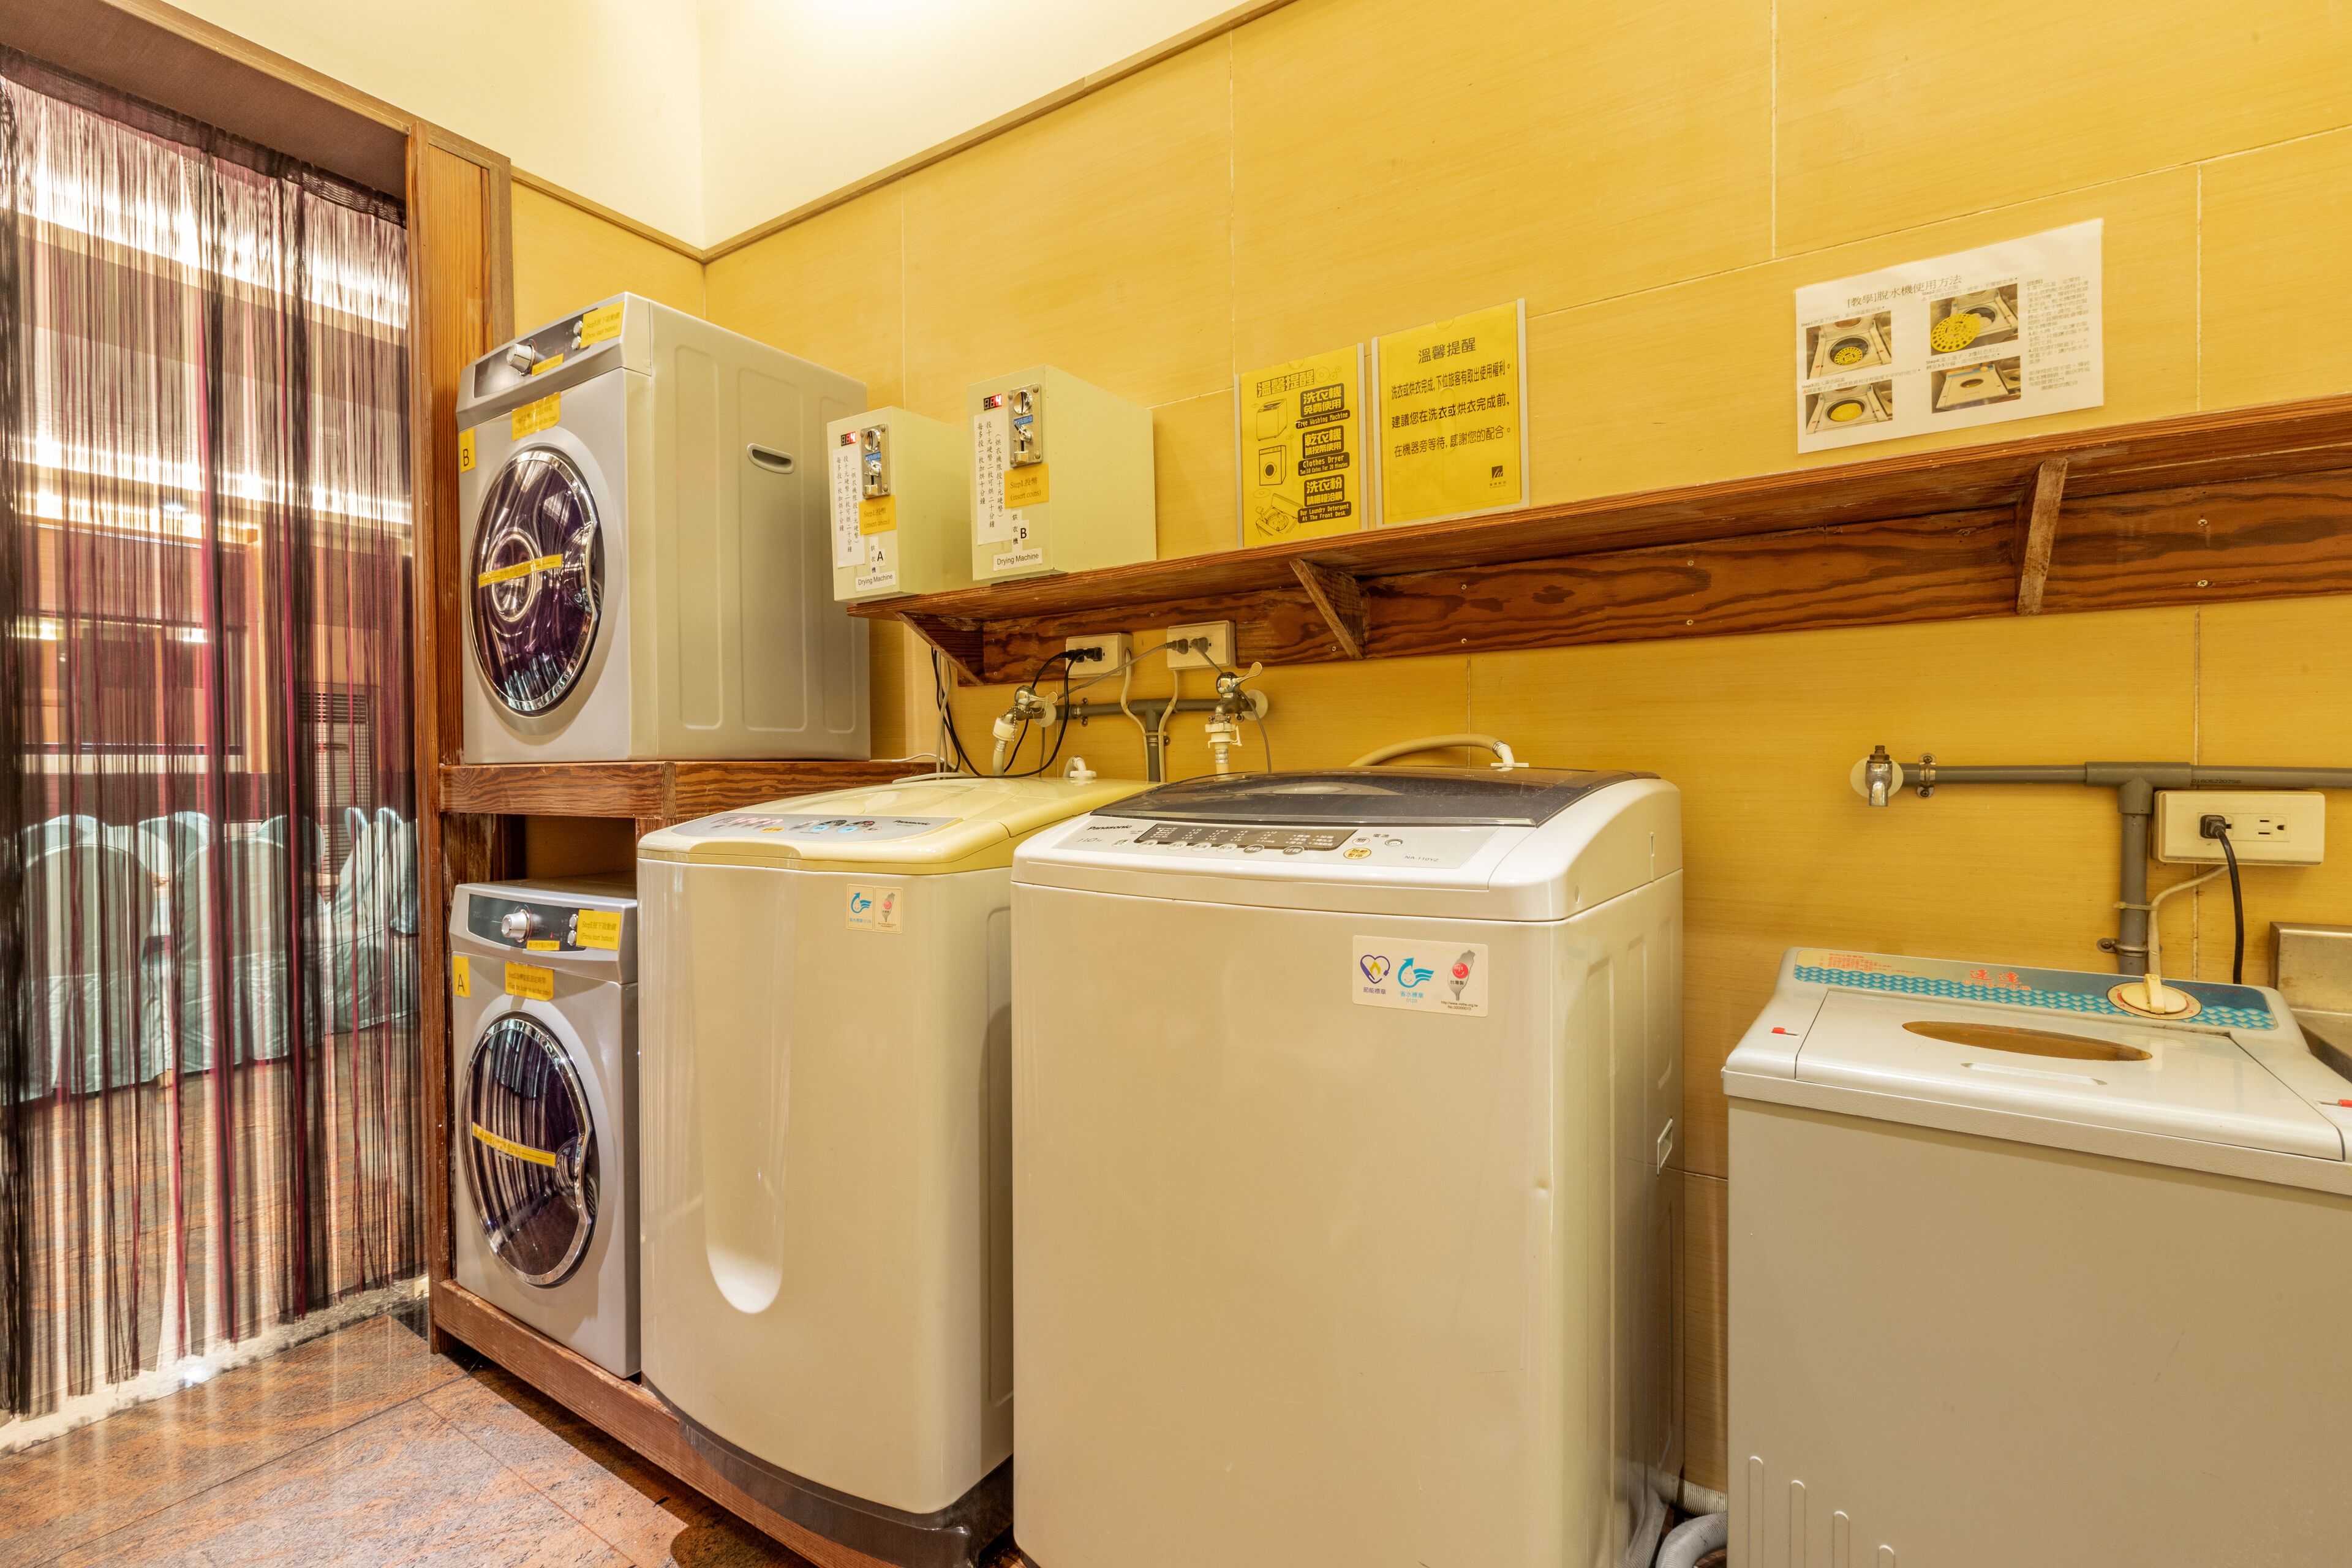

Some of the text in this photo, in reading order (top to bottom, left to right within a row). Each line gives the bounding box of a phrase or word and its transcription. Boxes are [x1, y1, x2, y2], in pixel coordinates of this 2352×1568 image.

[1419, 337, 1476, 364] 溫馨提醒
[1257, 369, 1314, 398] 溫馨提醒
[1303, 385, 1342, 404] 洗衣機
[1303, 399, 1341, 415] 免費使用
[1310, 417, 1329, 426] Washing
[1330, 412, 1348, 421] Machine
[1305, 428, 1341, 446] 乾衣機
[1305, 441, 1341, 456] 請投幣使用
[462, 448, 470, 467] B
[1303, 454, 1344, 468] Clothes Dryer
[1306, 477, 1342, 494] 洗衣粉
[1011, 489, 1041, 501] (insert coins)
[1309, 507, 1325, 515] Laundry
[1327, 503, 1349, 512] Detergent
[1020, 527, 1027, 539] B
[877, 551, 884, 562] A
[997, 552, 1039, 566] Drying Machine
[873, 573, 893, 582] Machine
[458, 974, 465, 992] A
[1363, 986, 1386, 995] 節能標章
[1400, 990, 1424, 999] 省水標章
